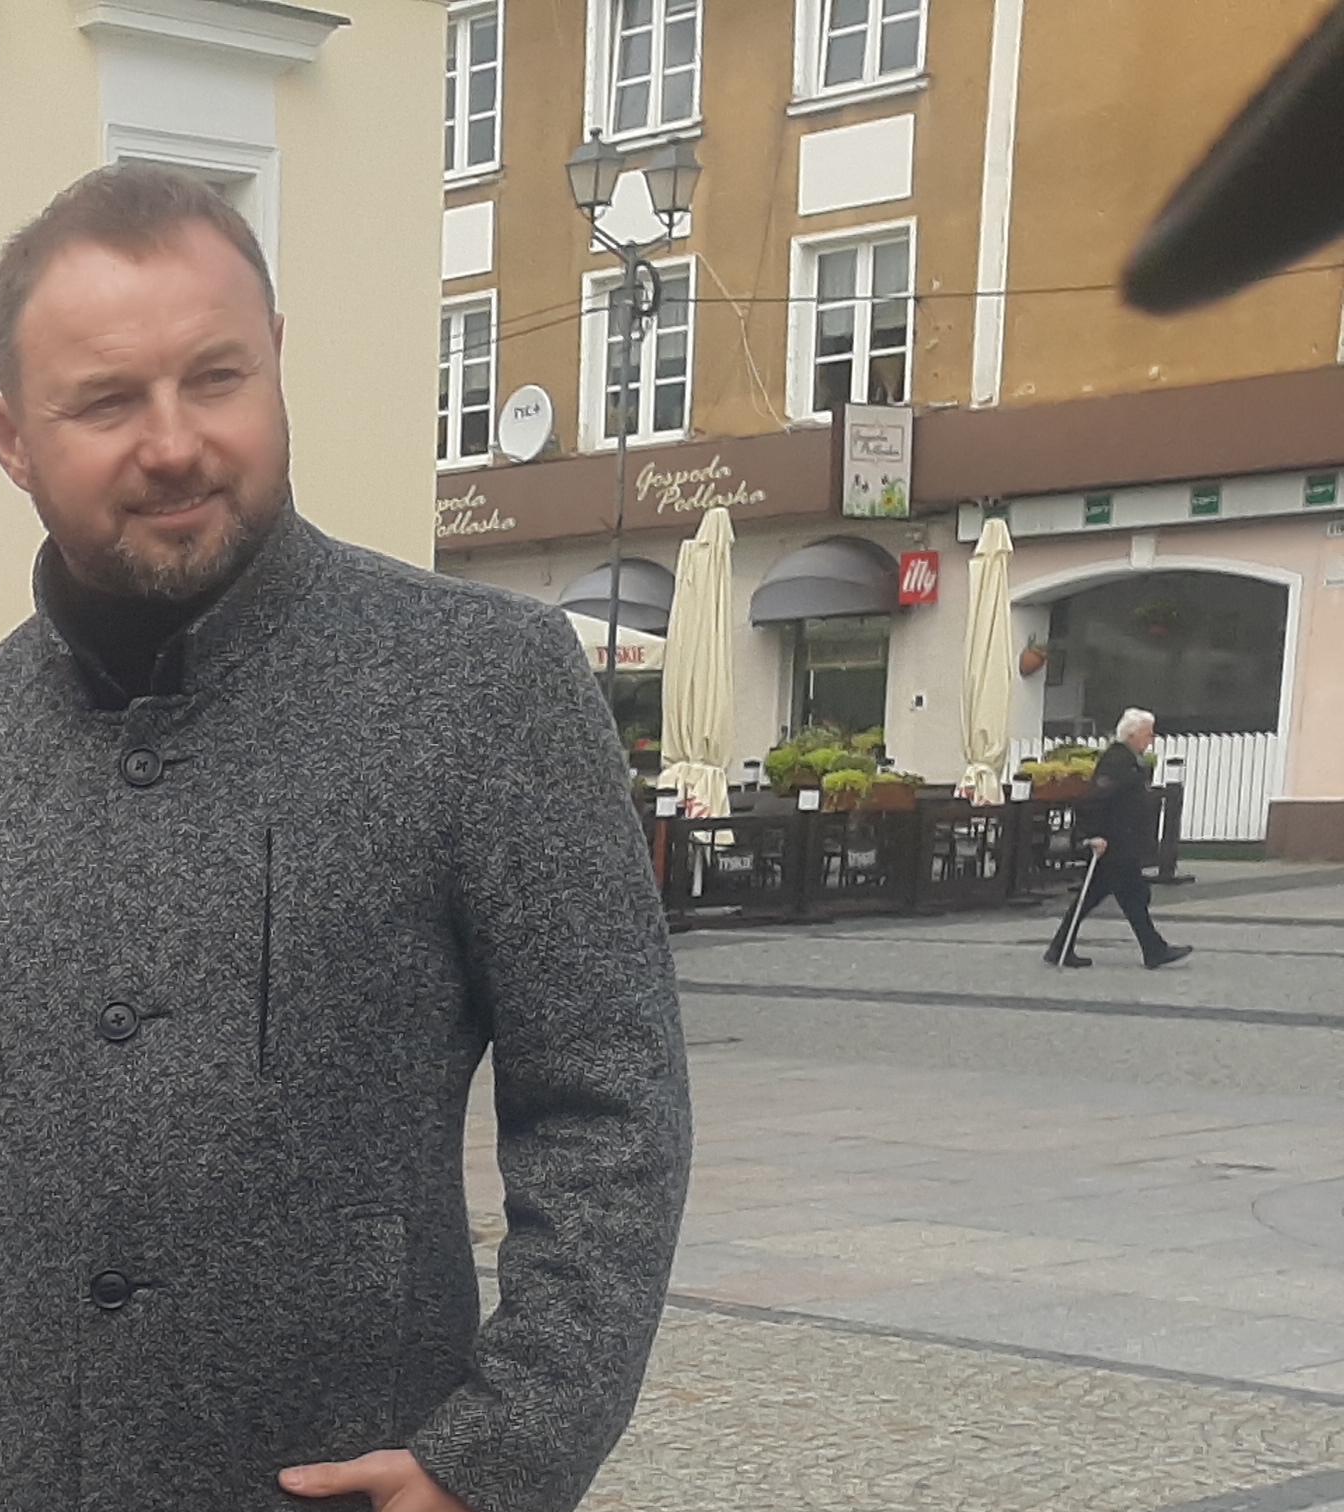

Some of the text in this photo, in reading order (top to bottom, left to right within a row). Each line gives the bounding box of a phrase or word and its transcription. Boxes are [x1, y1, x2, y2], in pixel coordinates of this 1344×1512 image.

[635, 454, 733, 501] Gospoda
[437, 484, 487, 512] poda
[655, 480, 766, 514] Podlaska
[903, 558, 936, 598] illy
[595, 646, 645, 664] TSKIE
